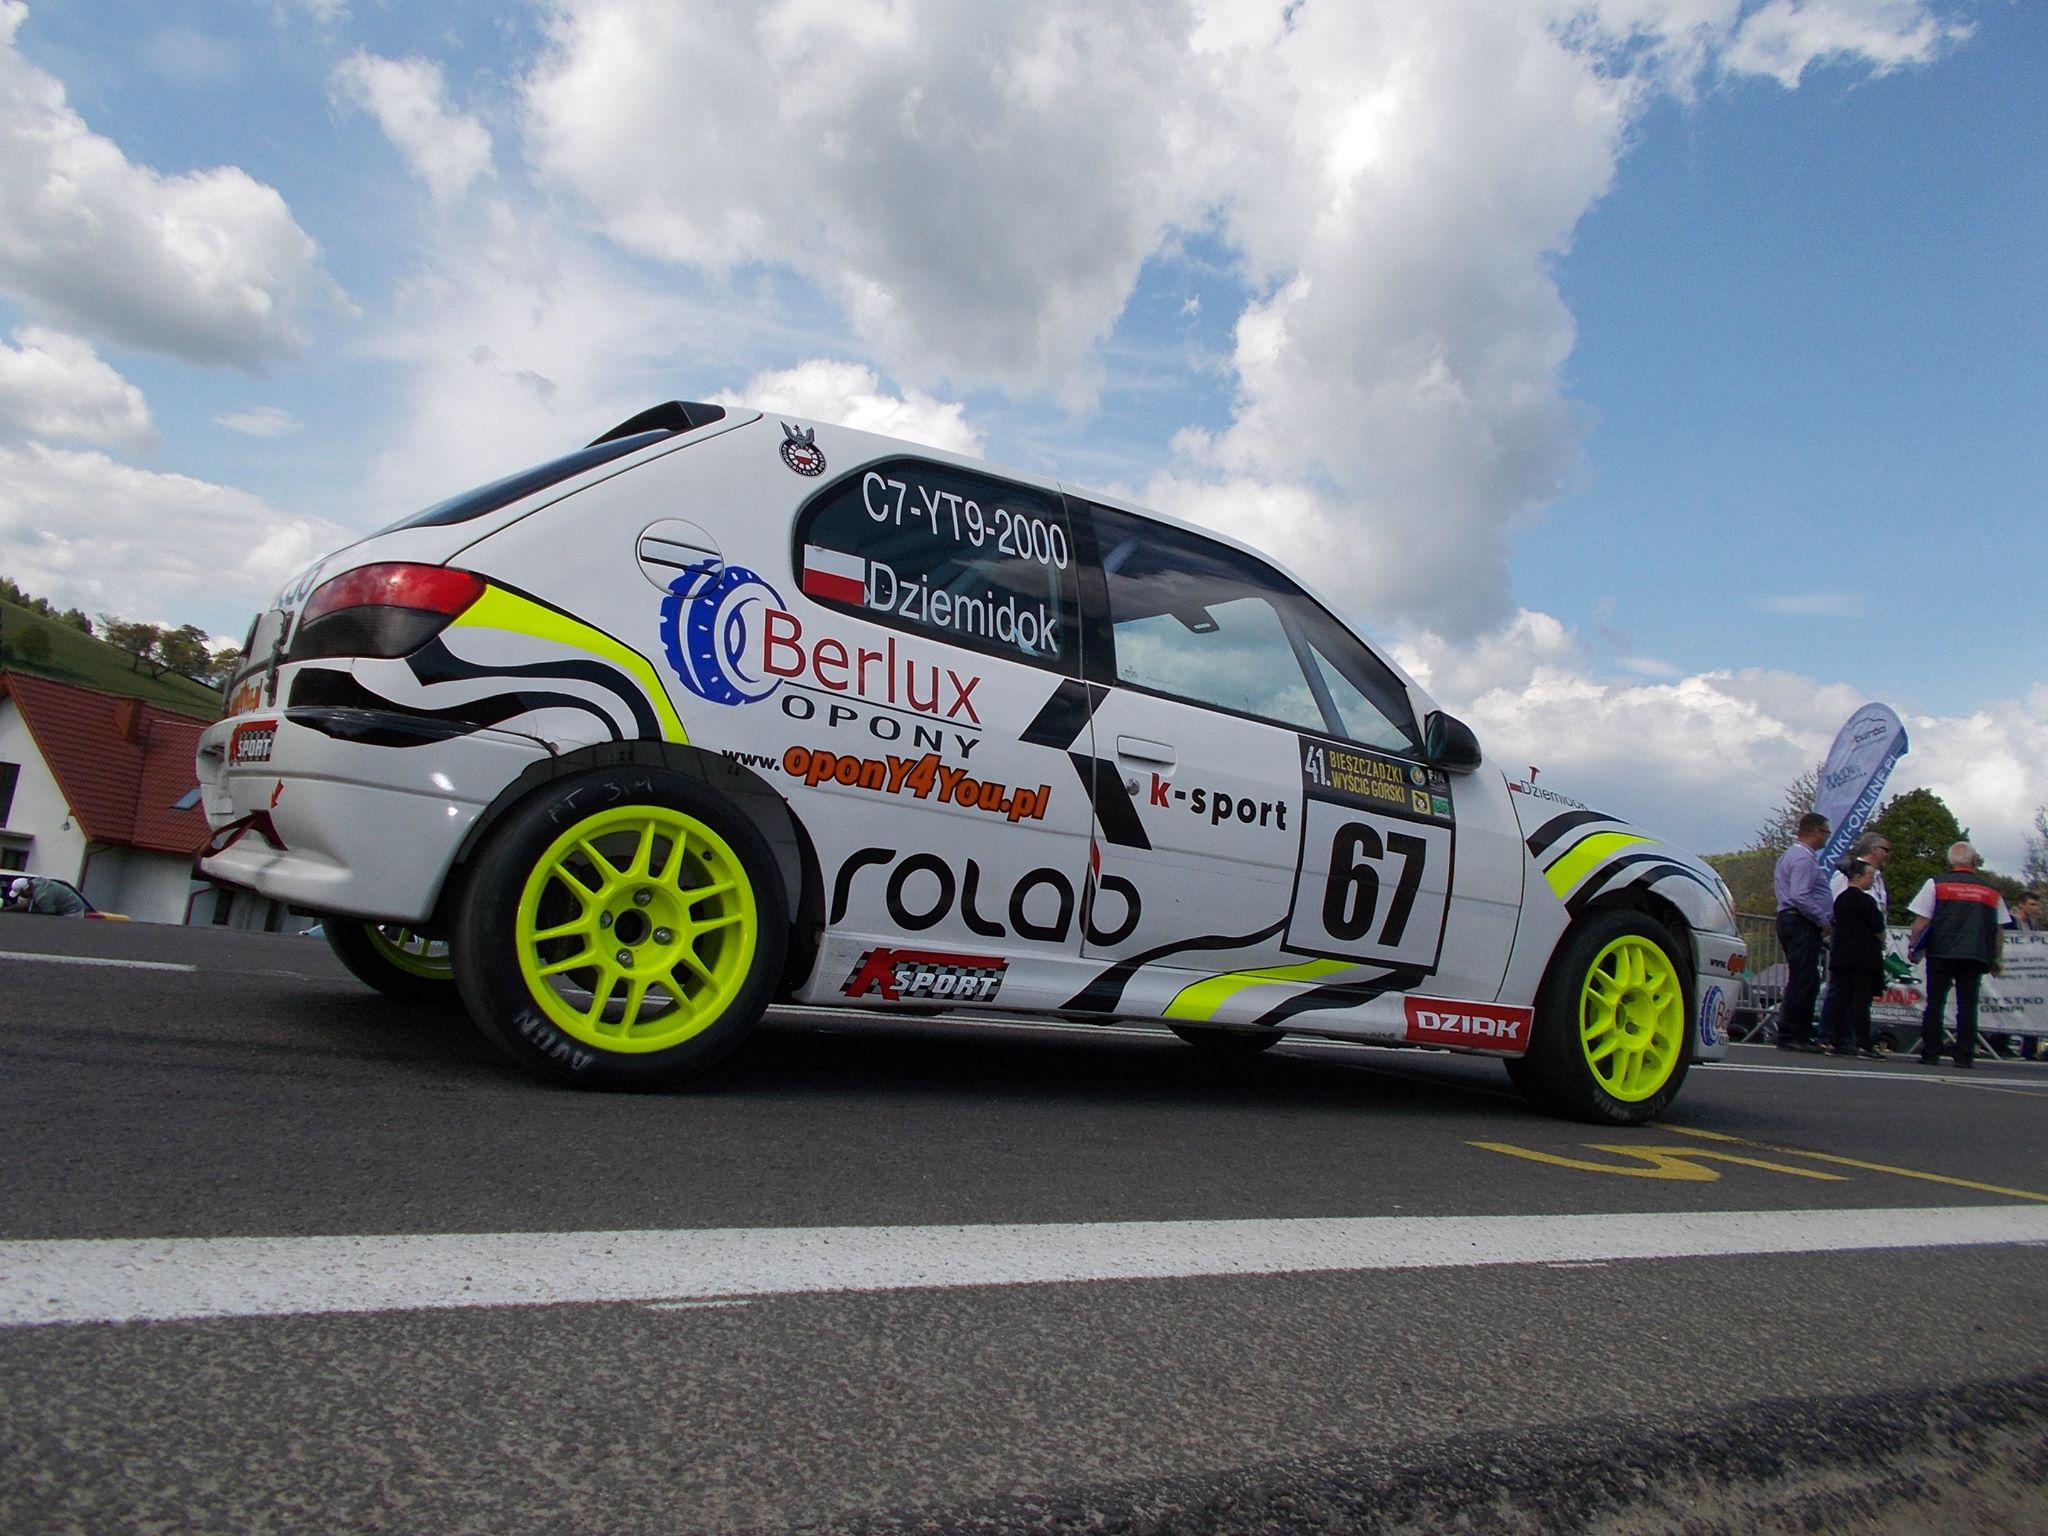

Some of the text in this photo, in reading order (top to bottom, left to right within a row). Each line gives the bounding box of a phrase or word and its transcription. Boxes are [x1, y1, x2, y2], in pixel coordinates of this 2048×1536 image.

[863, 471, 1069, 570] C7-YT9-2000
[869, 560, 1059, 653] Dziemidok
[762, 607, 982, 725] Berlux
[780, 693, 981, 760] OPONY
[1304, 744, 1332, 787] 41.
[1328, 750, 1405, 784] BIESZCZADZKI
[1330, 770, 1370, 797] WYŚCIG
[1371, 779, 1407, 804] GÓRSKI
[1149, 772, 1288, 831] k-sport
[1322, 821, 1427, 948] 67
[1415, 1010, 1522, 1040] DZIAK
